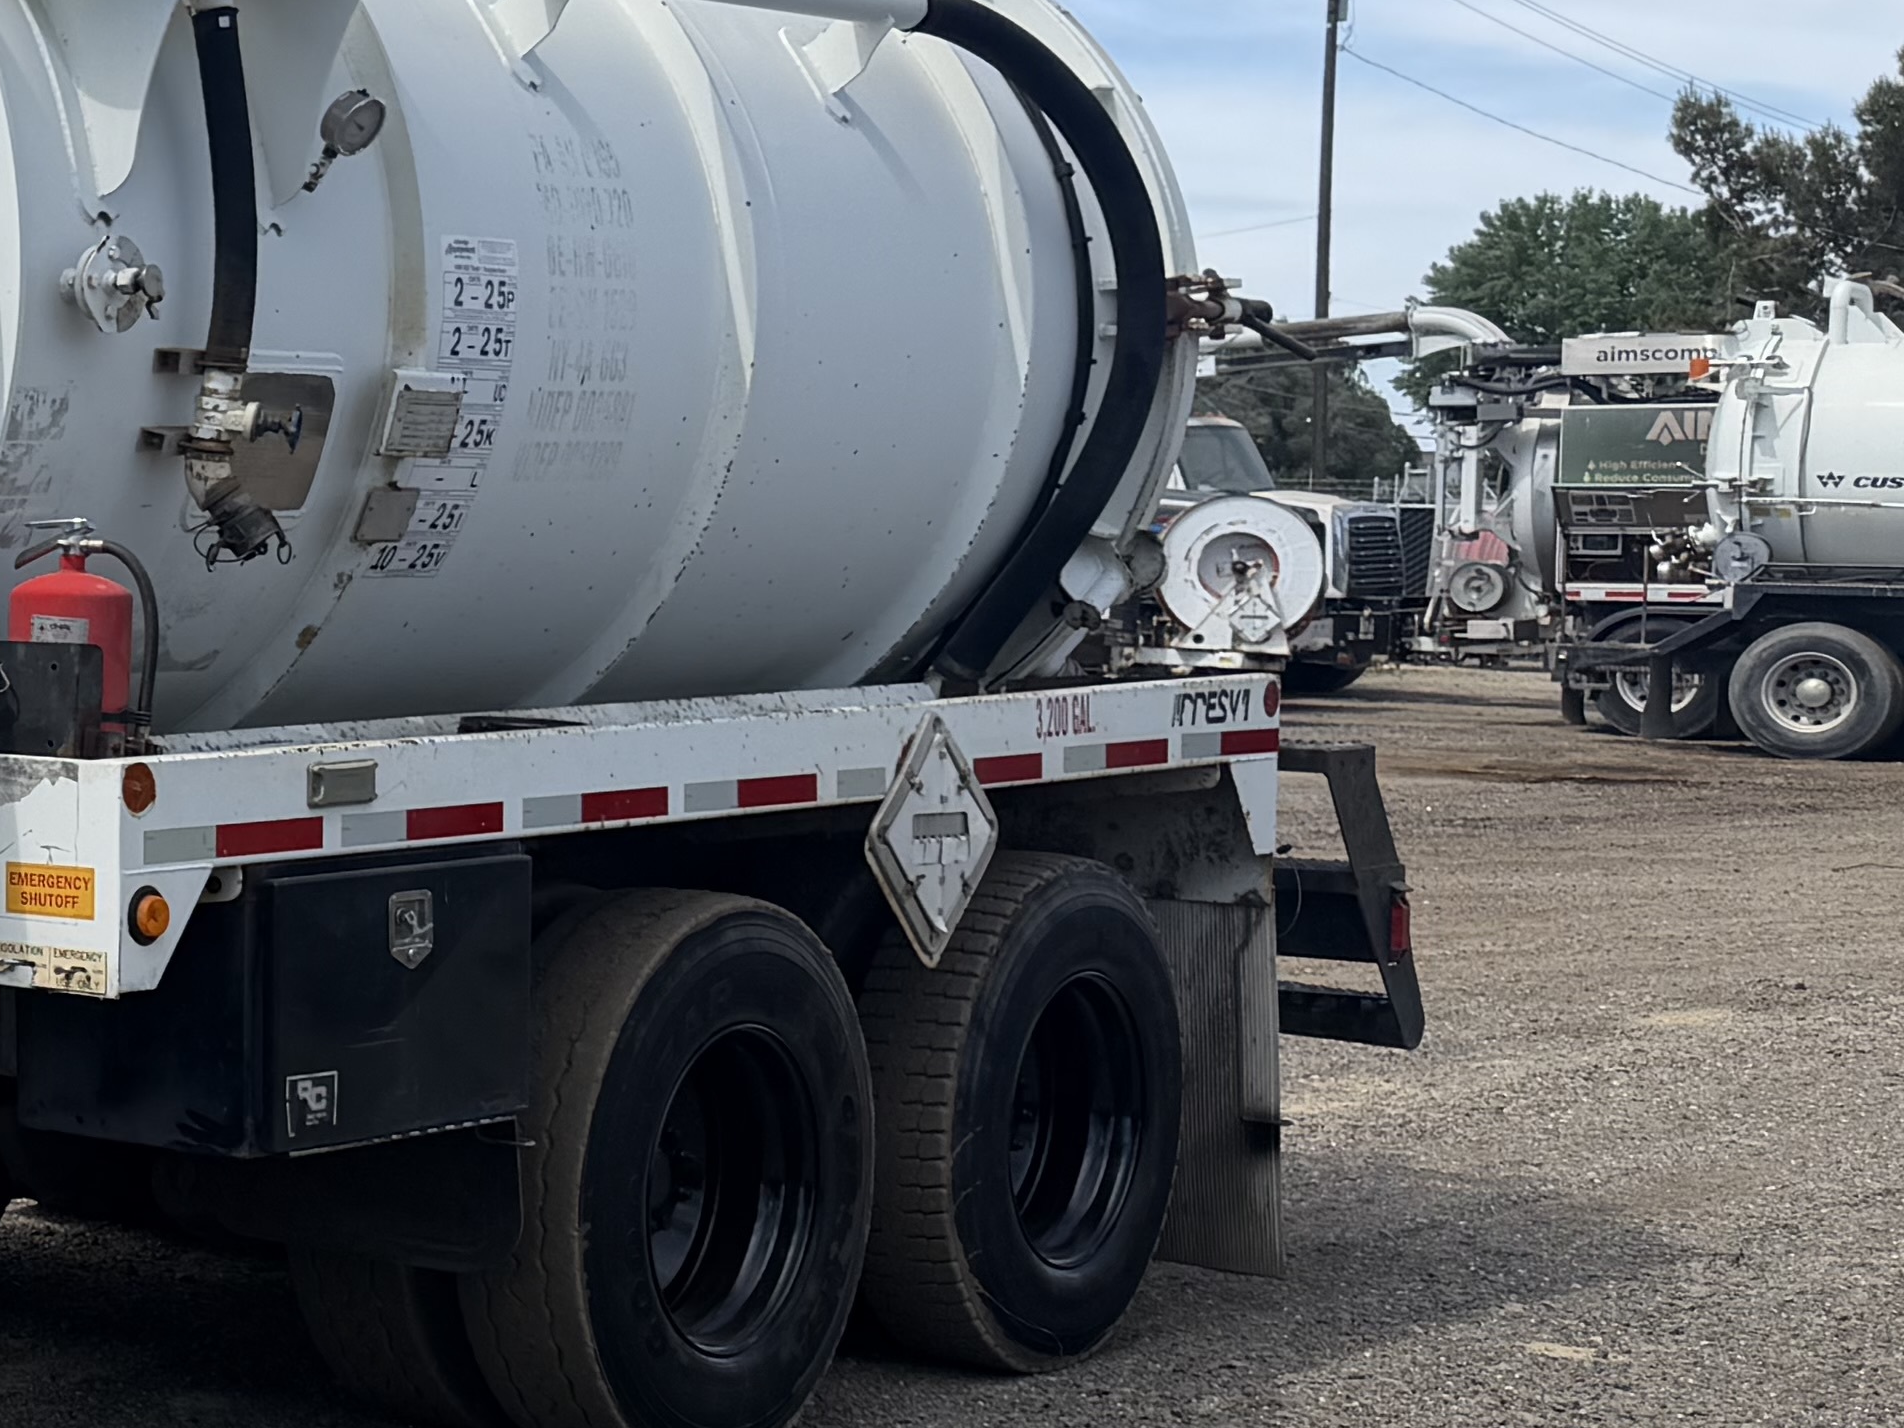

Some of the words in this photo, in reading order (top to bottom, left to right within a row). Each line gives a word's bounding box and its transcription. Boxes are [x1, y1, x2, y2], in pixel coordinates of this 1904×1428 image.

[1035, 695, 1069, 744] 3,200
[8, 871, 92, 891] EMERGENCY
[20, 890, 80, 909] SHUTOFF
